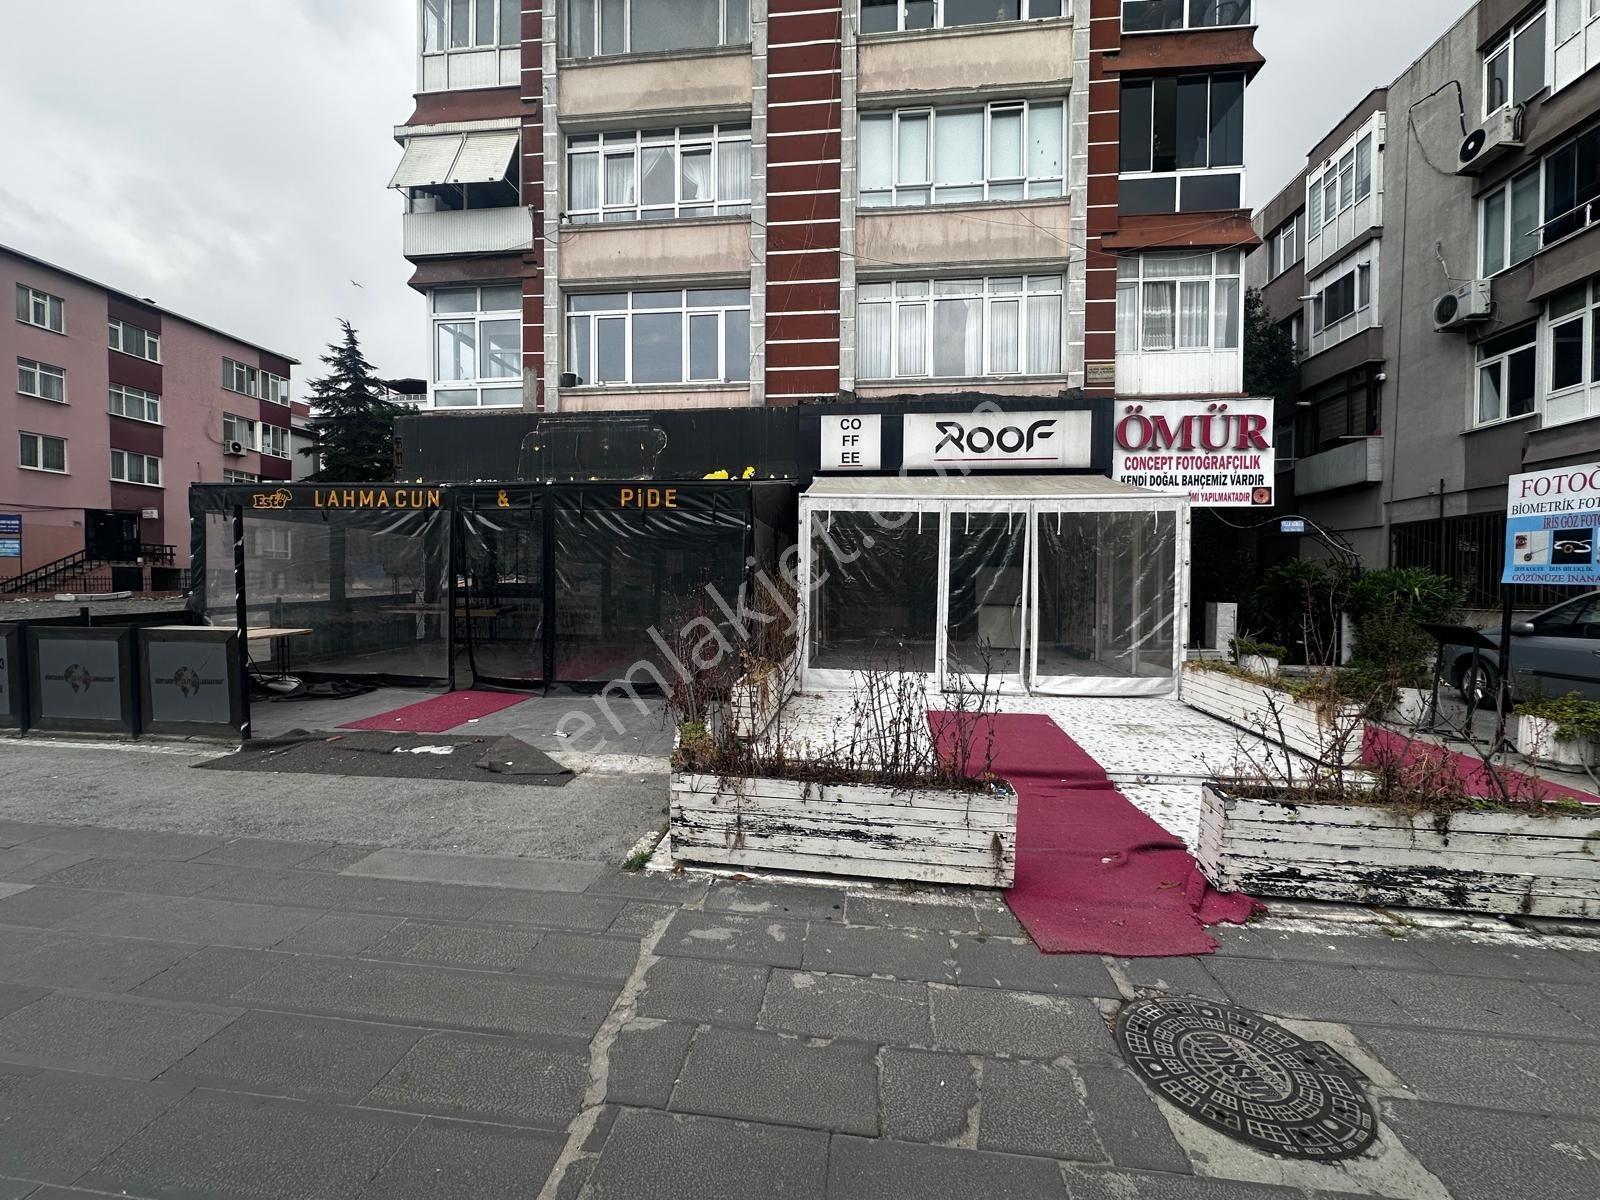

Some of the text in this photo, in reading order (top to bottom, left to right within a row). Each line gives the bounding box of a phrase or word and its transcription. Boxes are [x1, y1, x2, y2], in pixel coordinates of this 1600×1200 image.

[840, 418, 862, 430] CO
[1116, 403, 1270, 451] ÖMÜR
[842, 435, 859, 447] FF
[935, 419, 1058, 454] ROOF
[841, 452, 860, 464] EE
[1124, 451, 1261, 473] CONCEPT FOTOĞRAFÇILIK
[1120, 471, 1265, 490] KENDİ DOĞAL BAHÇEMİZ VARDIR
[314, 489, 440, 508] LAHMACUN
[497, 489, 510, 507] &
[1201, 492, 1250, 503] YAPILMAKTADIR
[1512, 498, 1575, 515] BİOMETRİK
[1543, 514, 1560, 529] İRİS
[1561, 513, 1579, 529] GÖZ
[1512, 573, 1565, 583] GÖZÜNÜZE
